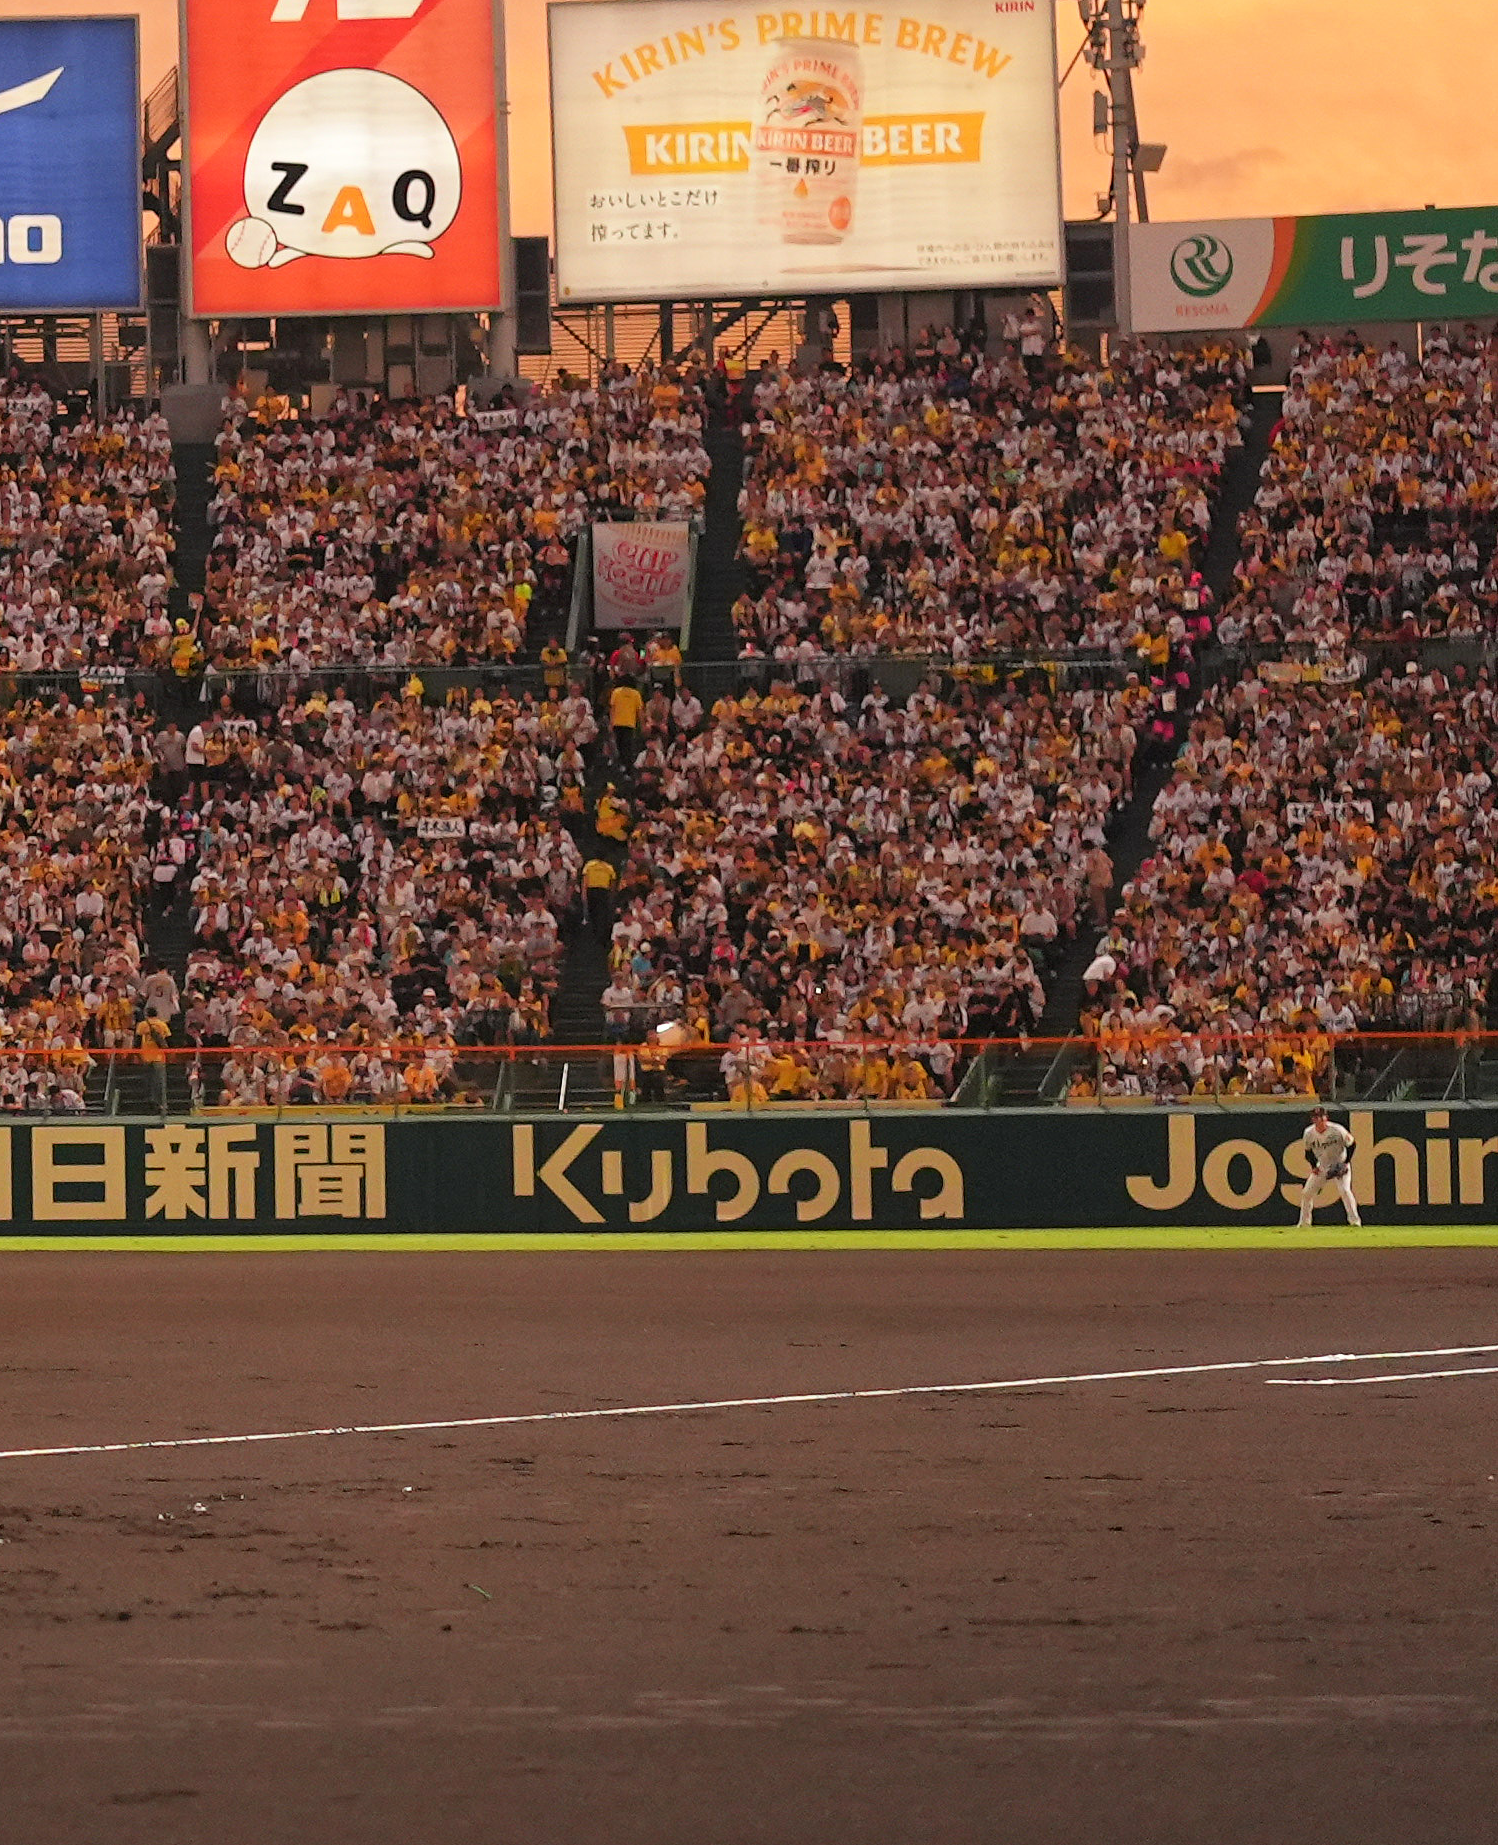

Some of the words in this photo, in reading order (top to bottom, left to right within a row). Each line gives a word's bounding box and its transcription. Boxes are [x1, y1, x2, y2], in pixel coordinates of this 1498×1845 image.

[994, 0, 1035, 14] KIRIN
[592, 19, 741, 99] KIRIN'S
[756, 11, 883, 46] PRIME
[897, 17, 1013, 80] BREW
[645, 129, 751, 166] KIRIN
[861, 122, 963, 155] BEER
[811, 134, 854, 154] BEER
[267, 162, 436, 236] ZAQ
[590, 189, 718, 209] おいしいとこだけ
[511, 1119, 965, 1223] Kubota
